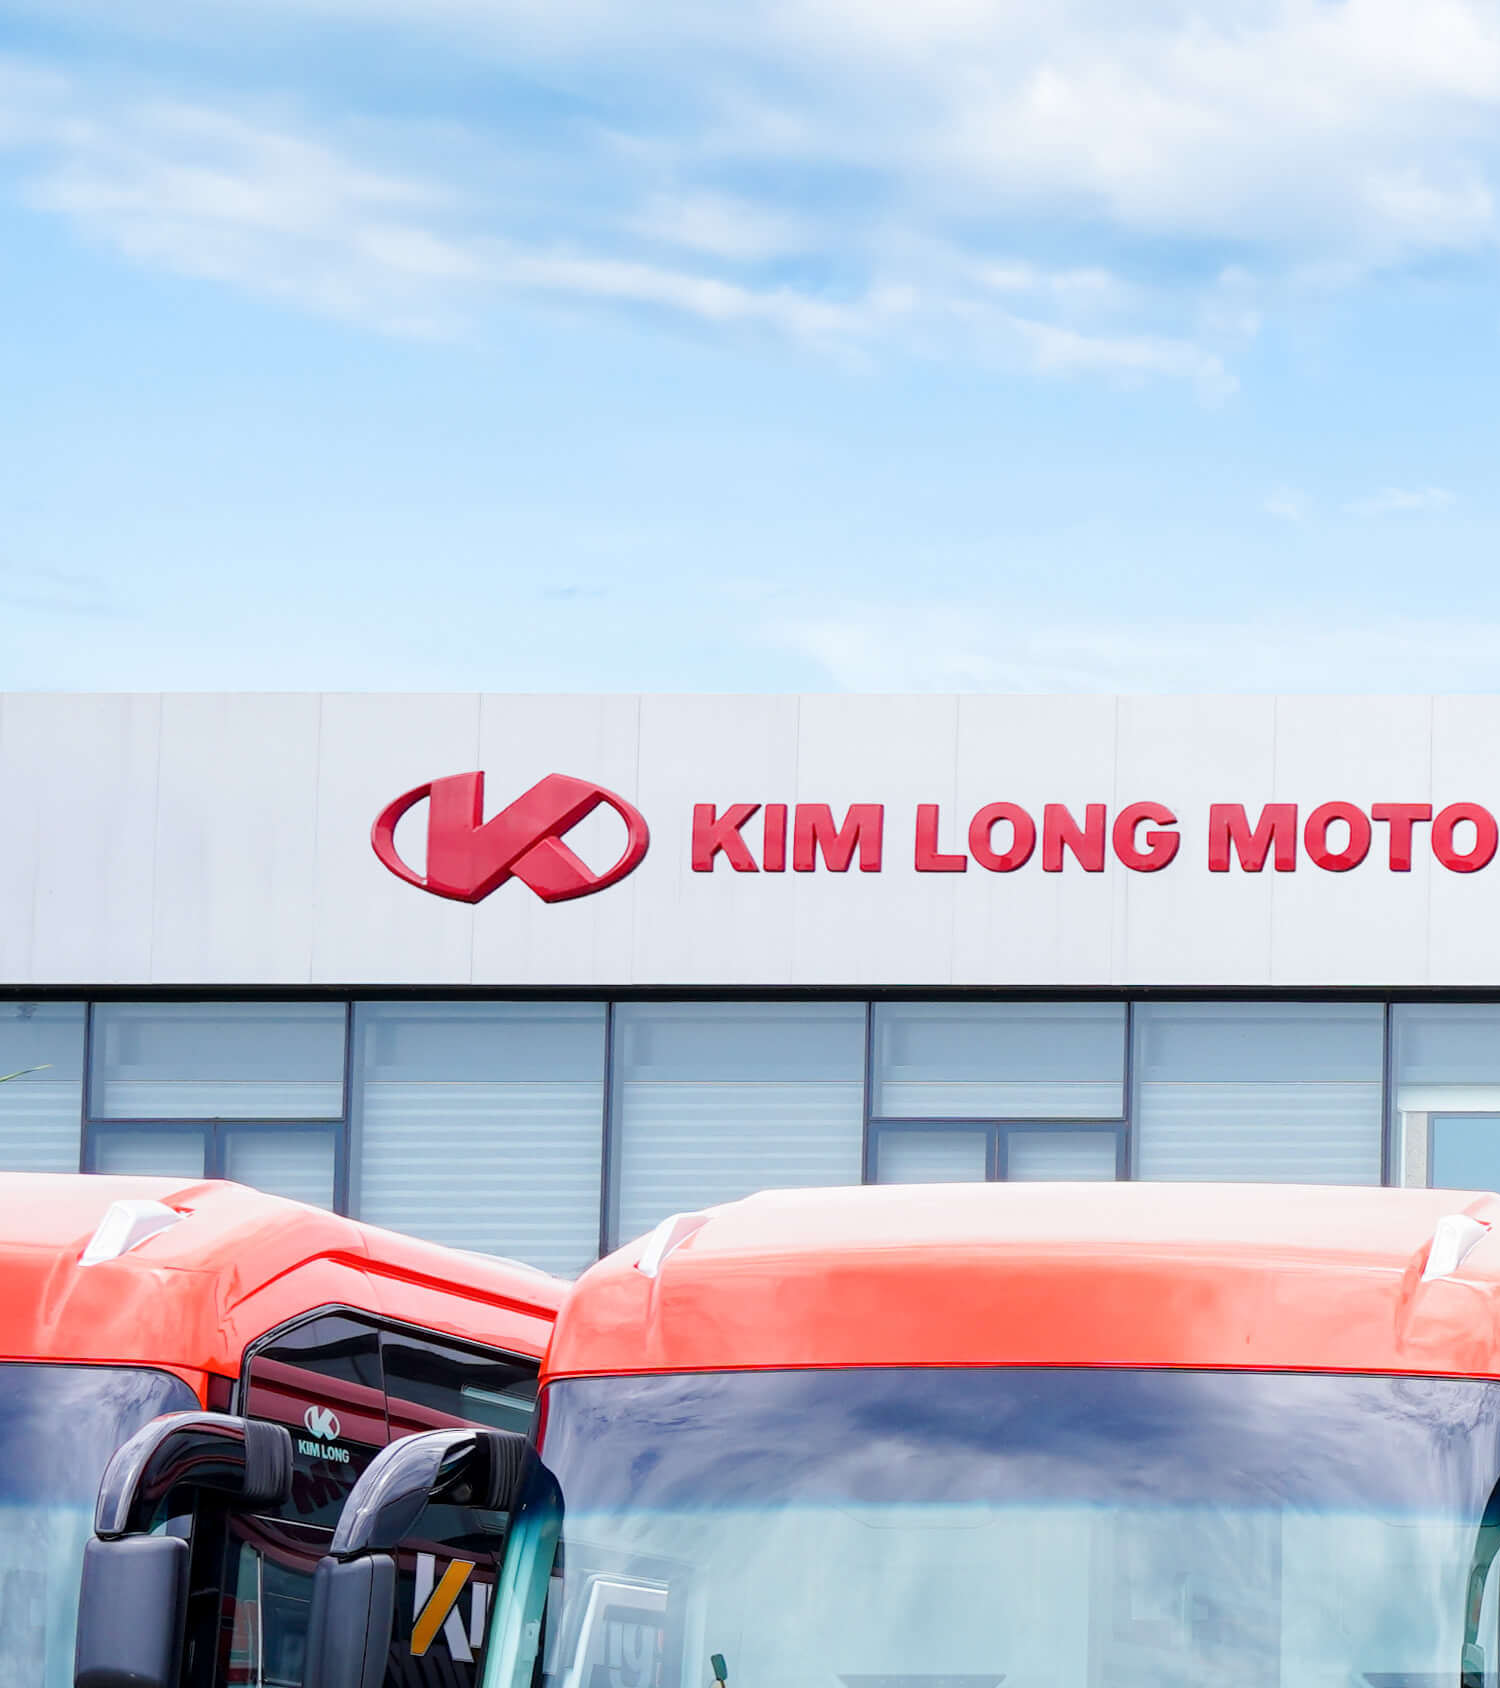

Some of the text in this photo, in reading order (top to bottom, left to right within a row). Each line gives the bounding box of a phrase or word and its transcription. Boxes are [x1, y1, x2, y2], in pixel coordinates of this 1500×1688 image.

[691, 802, 887, 874] KIM
[914, 801, 1181, 874] LONG
[298, 1440, 350, 1464] KIM LONG
